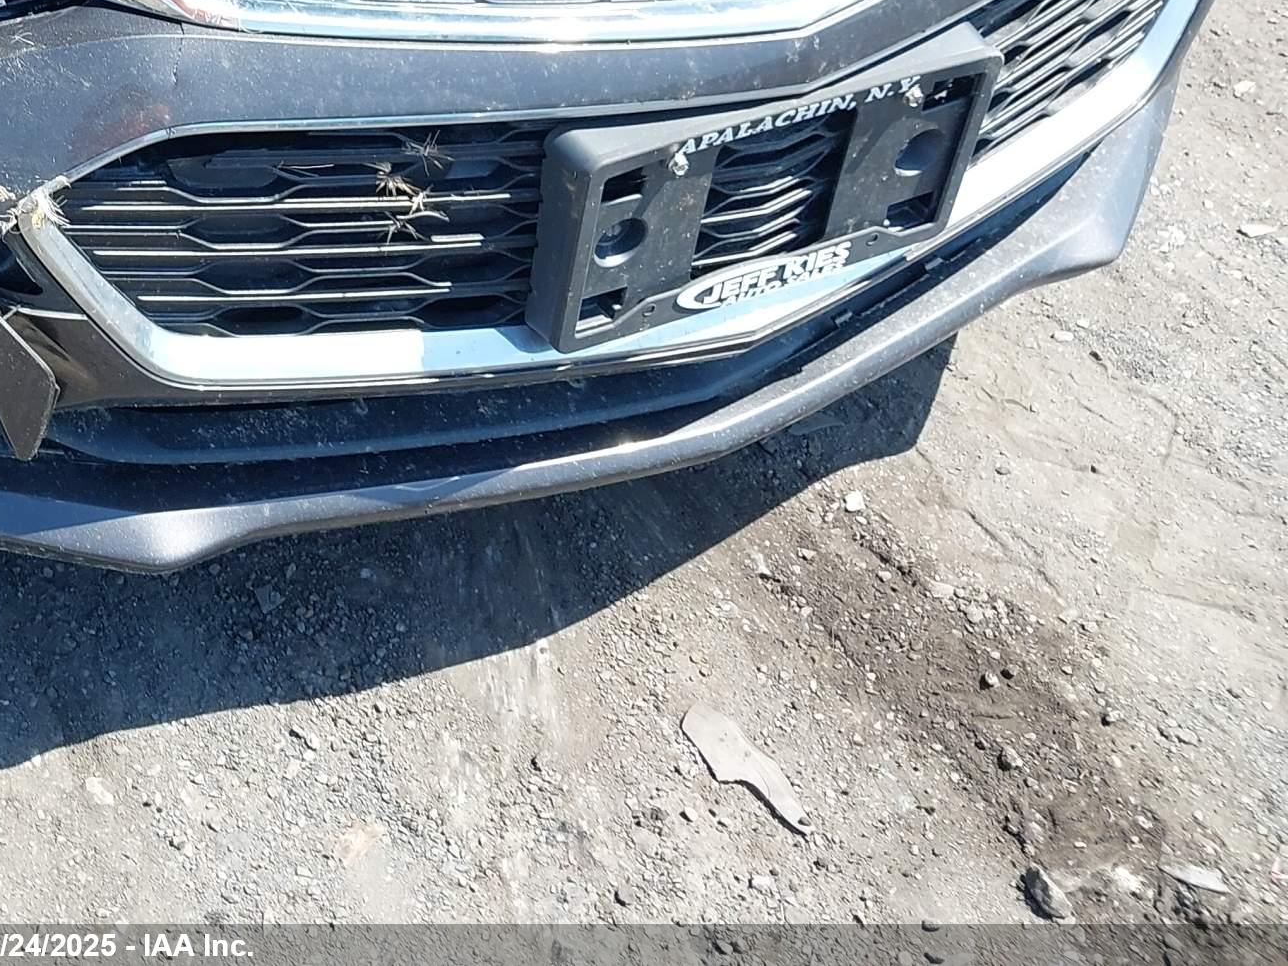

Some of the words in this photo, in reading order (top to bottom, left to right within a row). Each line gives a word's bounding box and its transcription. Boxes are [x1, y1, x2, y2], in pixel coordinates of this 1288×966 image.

[678, 93, 857, 156] APALACHIN,
[703, 265, 780, 305] JEFF
[783, 241, 852, 280] KIES
